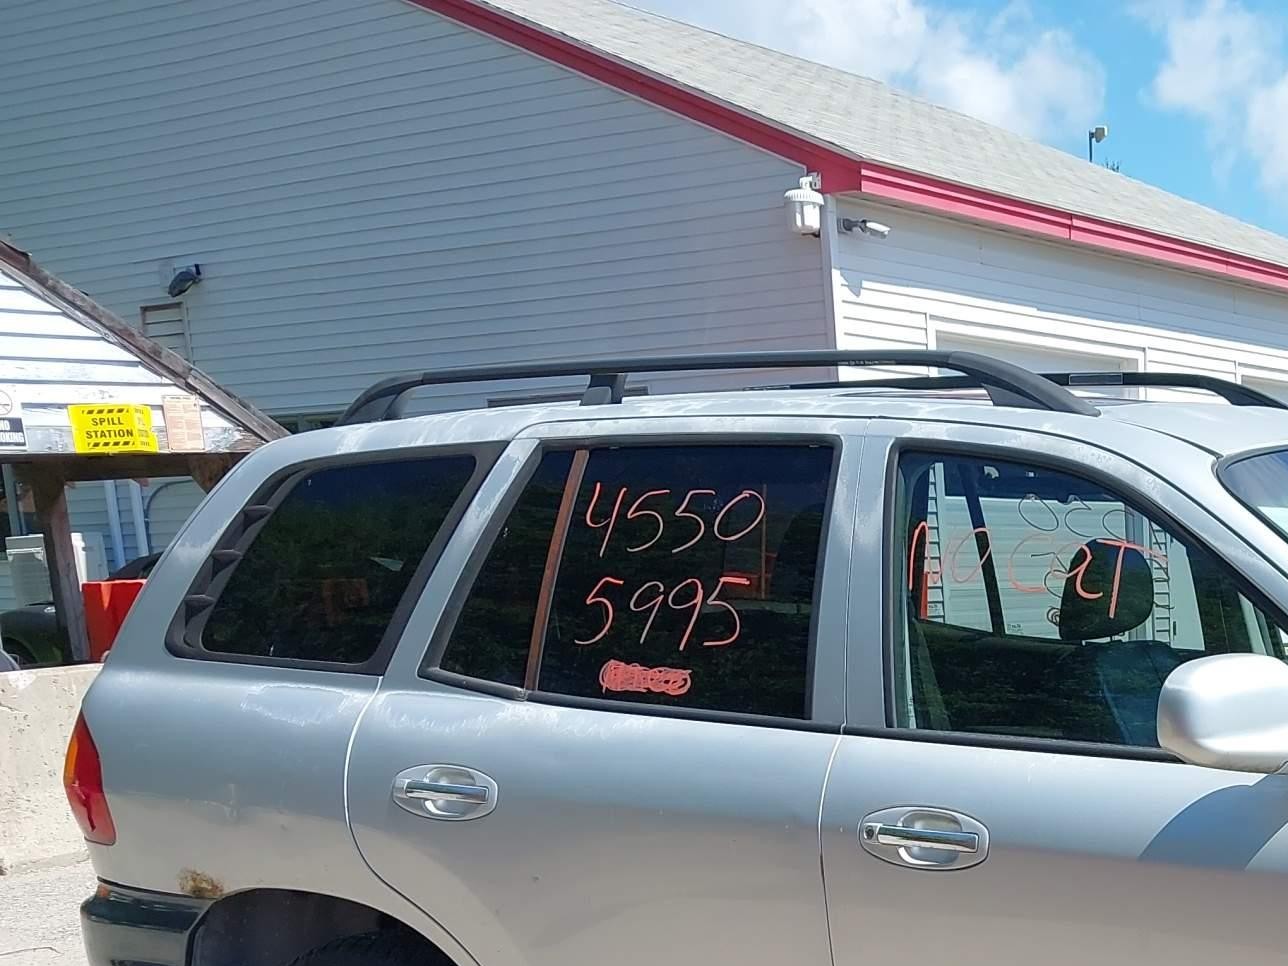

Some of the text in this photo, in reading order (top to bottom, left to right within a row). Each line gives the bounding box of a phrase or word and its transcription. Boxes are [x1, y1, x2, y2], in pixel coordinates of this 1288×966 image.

[91, 416, 124, 426] SPILL
[0, 431, 24, 443] OKING
[86, 429, 134, 439] STATION
[585, 482, 765, 558] 4550
[574, 577, 750, 651] 5995
